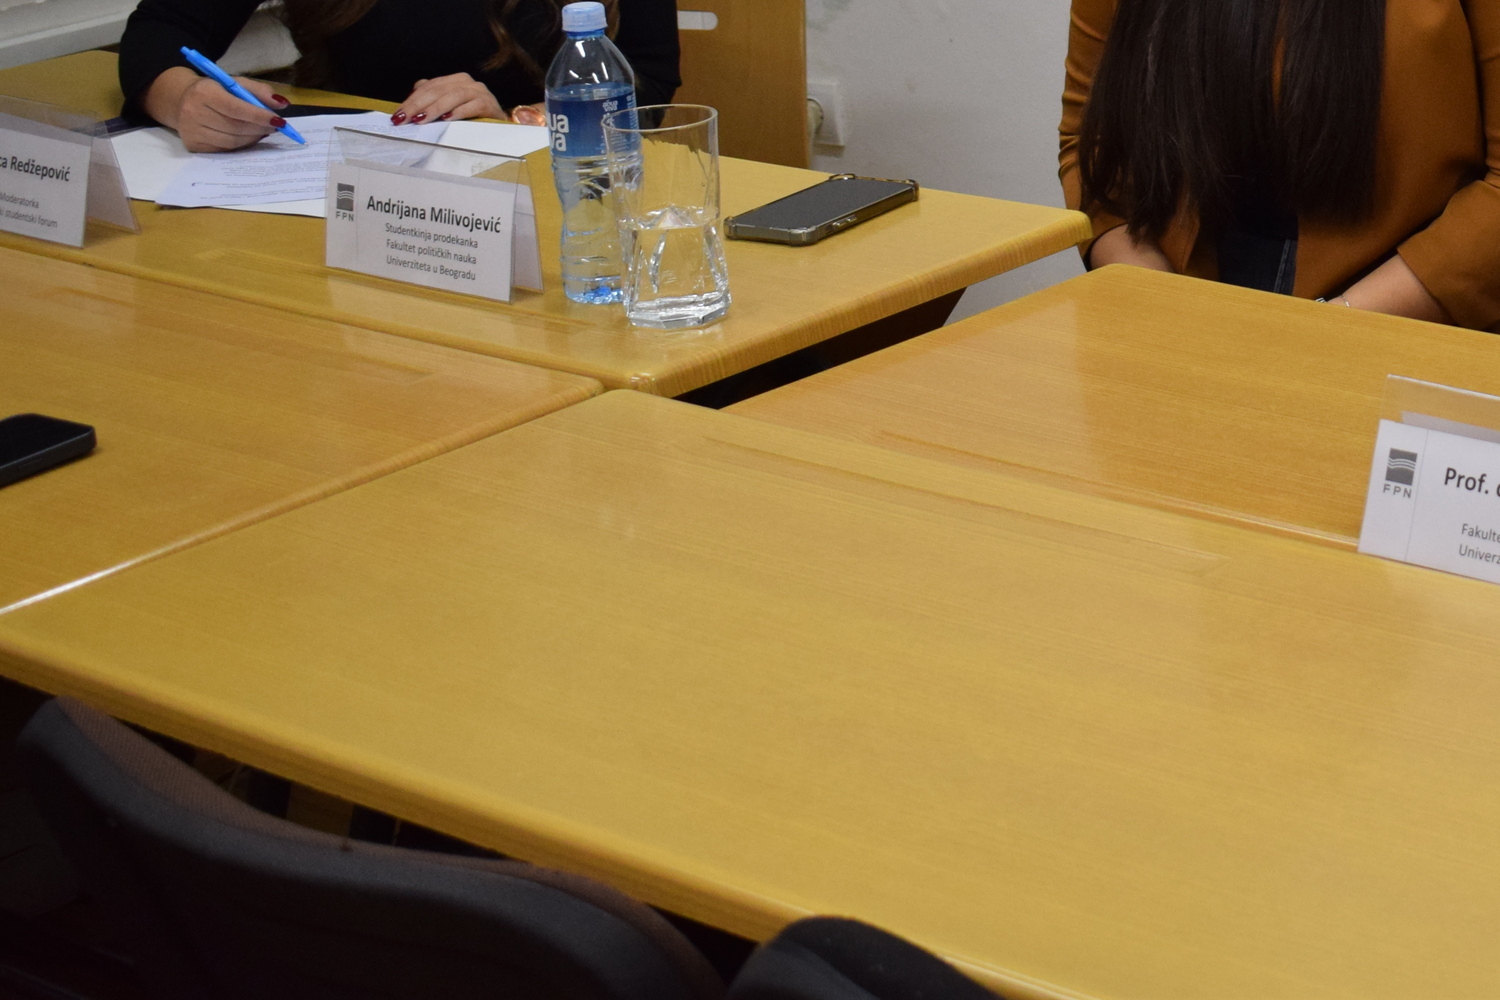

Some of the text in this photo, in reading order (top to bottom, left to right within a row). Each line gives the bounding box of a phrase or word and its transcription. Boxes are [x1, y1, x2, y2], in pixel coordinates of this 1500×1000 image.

[10, 156, 70, 181] Redžepović
[38, 215, 58, 228] forum
[335, 210, 354, 222] FPN
[367, 195, 501, 233] Andrijana Milivojević
[385, 222, 478, 248] Studentkinja prodekanka
[386, 238, 477, 264] Fakultet političkih nauka
[386, 255, 431, 272] Univerziteta
[440, 265, 476, 281] Beogradu
[1382, 483, 1412, 499] FPN
[1444, 467, 1490, 495] Prof.
